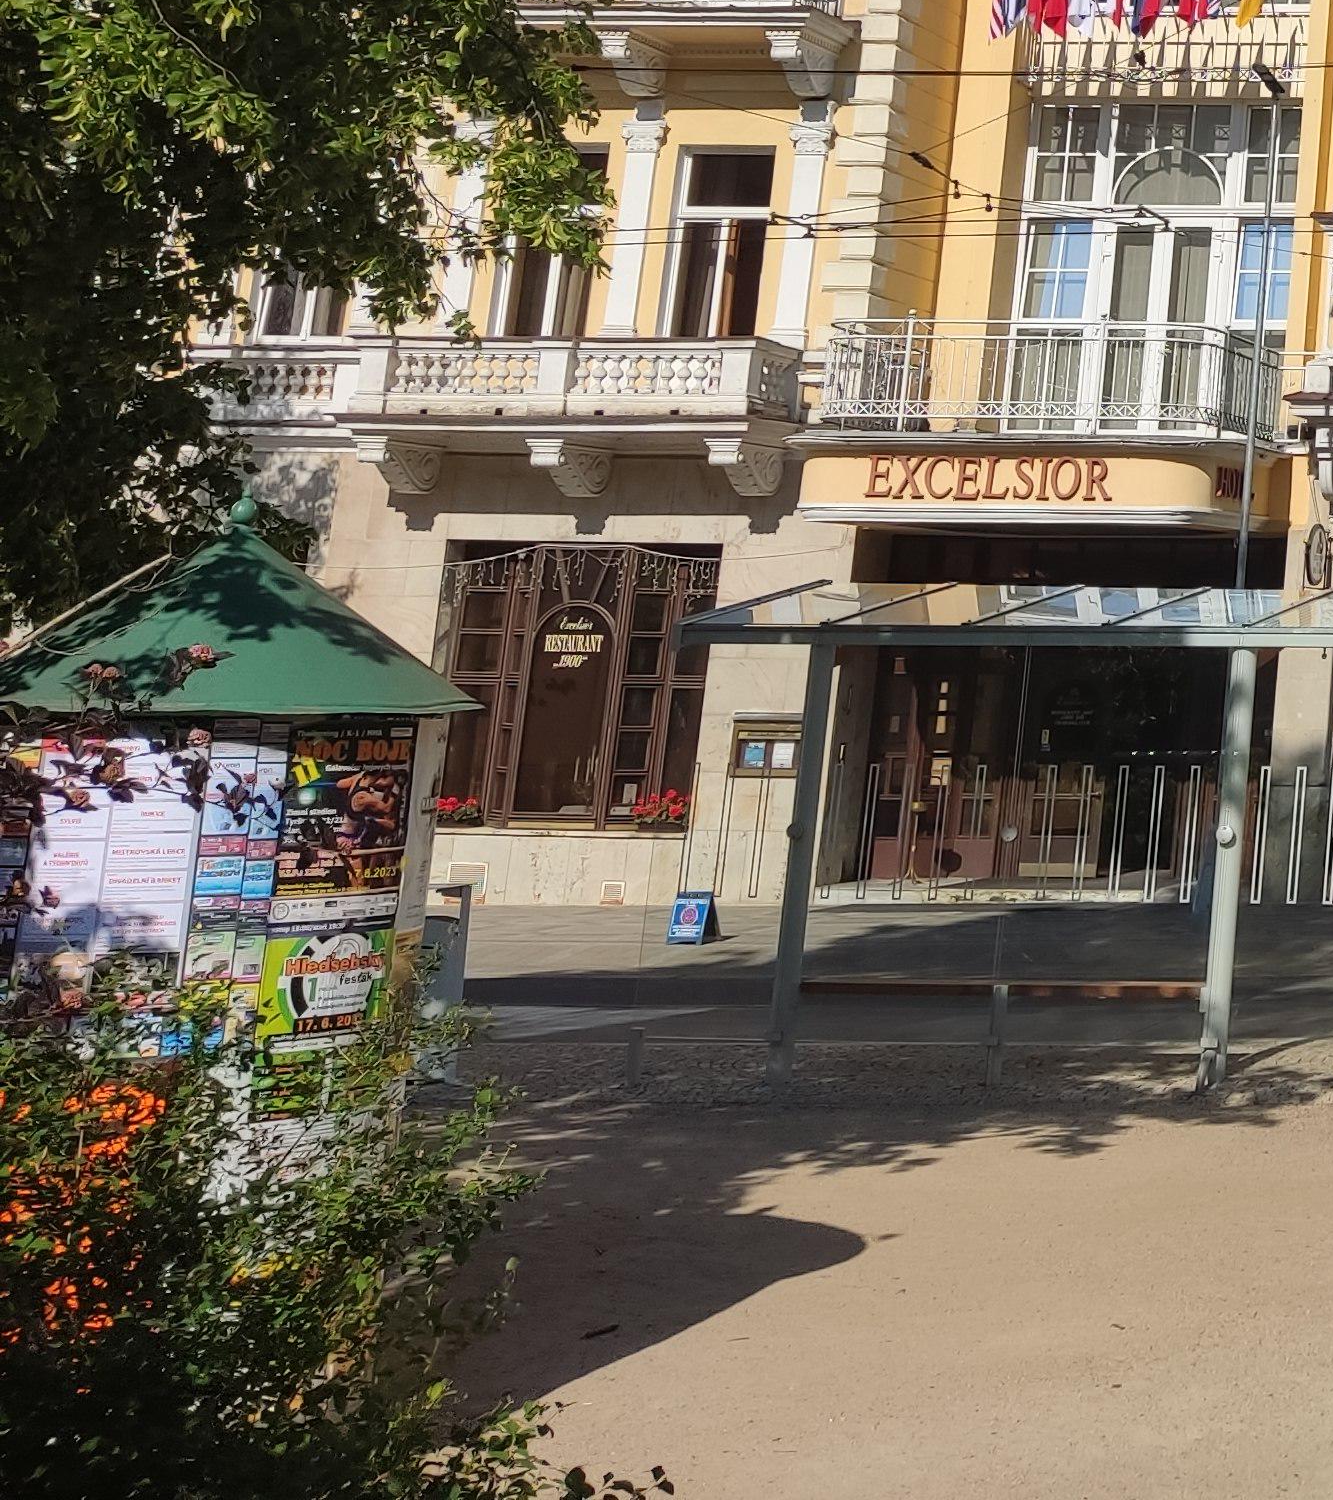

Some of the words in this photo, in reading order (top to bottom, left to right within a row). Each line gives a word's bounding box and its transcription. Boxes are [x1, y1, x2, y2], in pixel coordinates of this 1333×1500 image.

[864, 454, 1113, 501] EXCELSIOR
[544, 634, 604, 653] RESTAURANT
[295, 740, 350, 761] NOC
